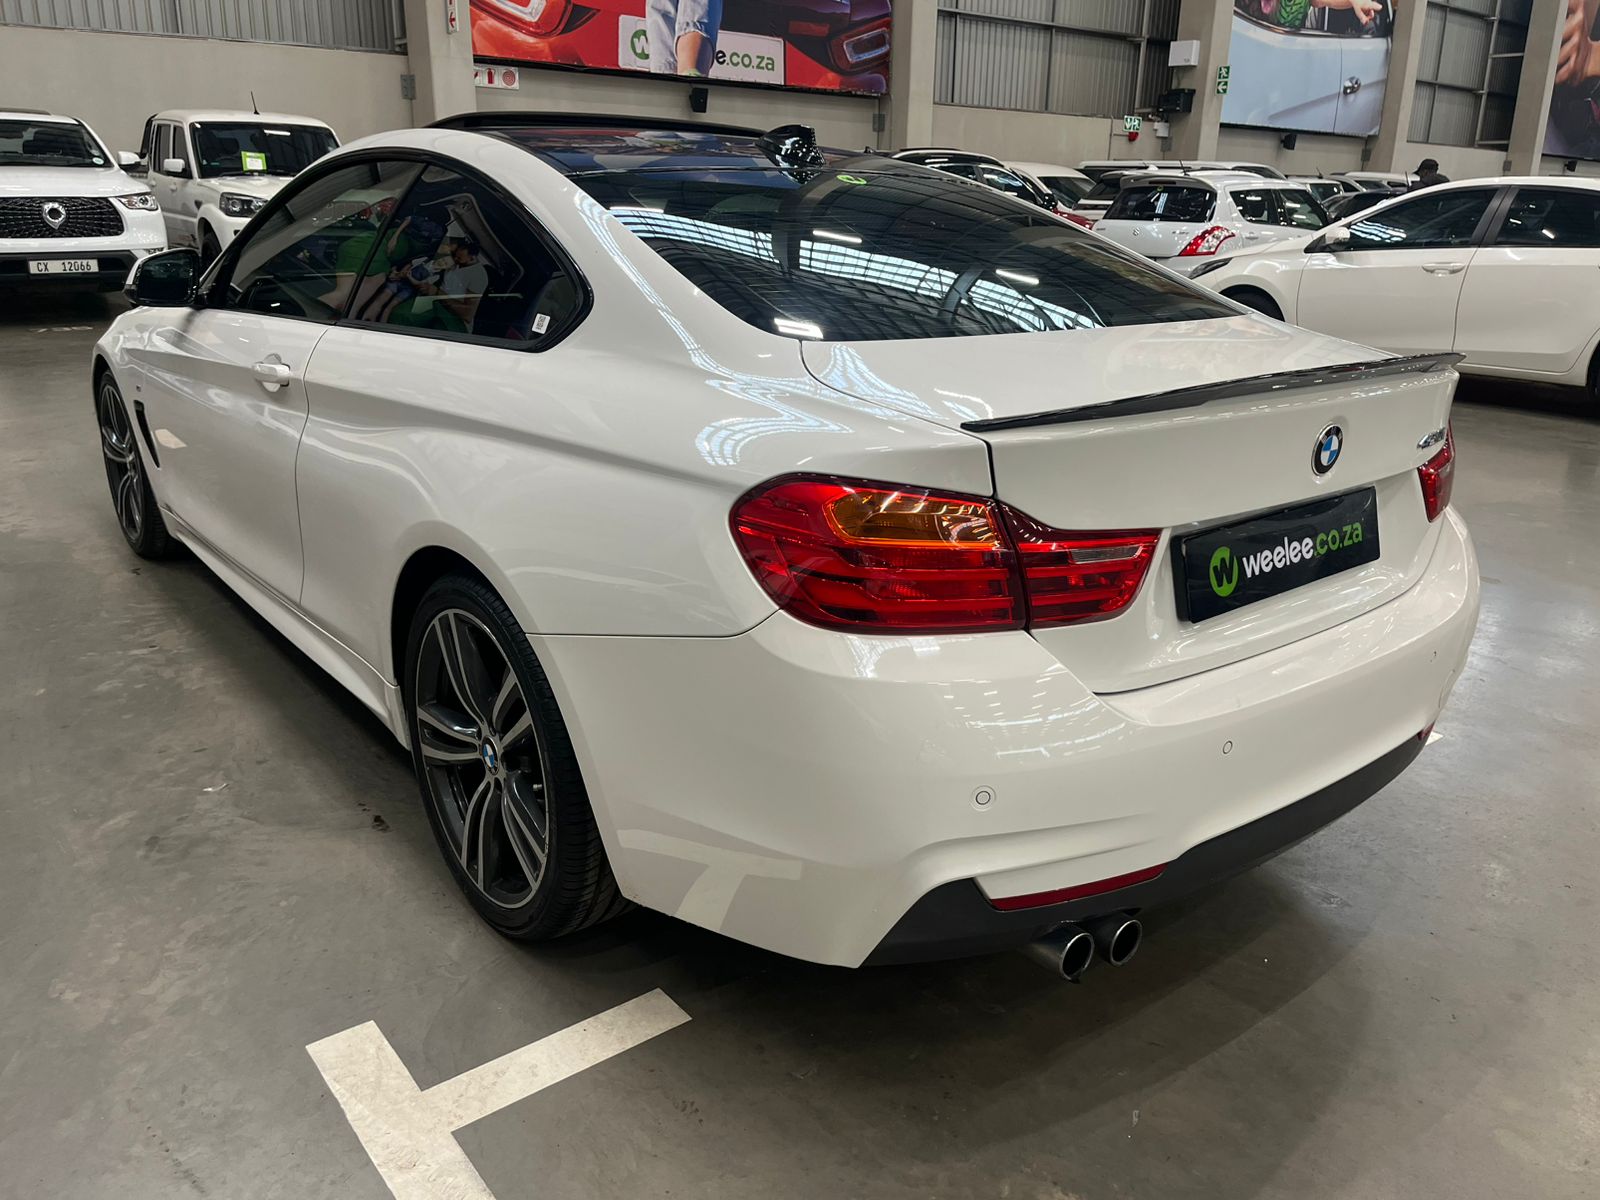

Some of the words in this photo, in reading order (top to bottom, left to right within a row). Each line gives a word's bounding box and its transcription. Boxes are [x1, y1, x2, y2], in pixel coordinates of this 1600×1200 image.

[715, 49, 775, 71] e.co.za
[37, 262, 49, 273] CX
[62, 261, 92, 272] 12066
[1242, 521, 1363, 578] weelee.co.za
